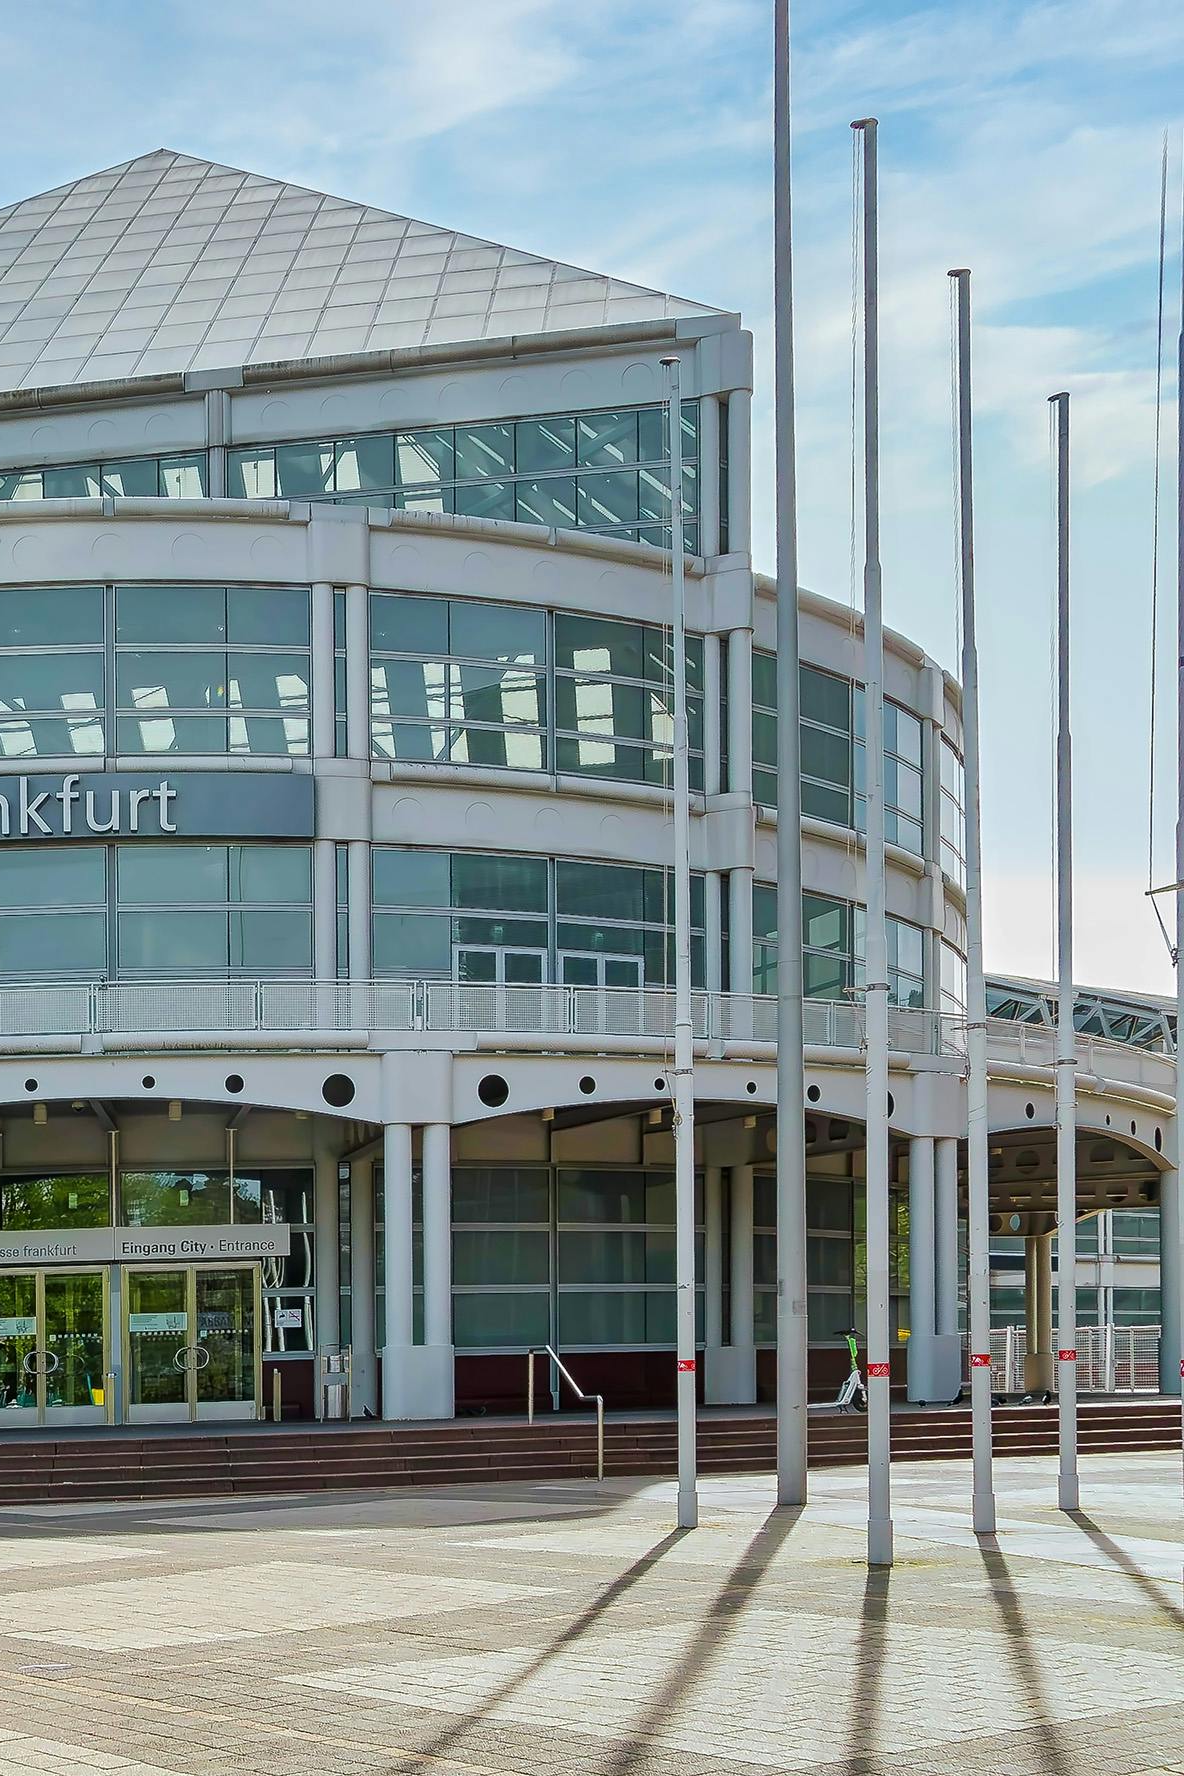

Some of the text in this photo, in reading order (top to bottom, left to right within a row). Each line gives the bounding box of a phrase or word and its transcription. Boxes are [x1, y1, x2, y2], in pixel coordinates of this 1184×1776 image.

[23, 1243, 77, 1257] frankfurt
[122, 1239, 275, 1256] Eingang City Entrance
